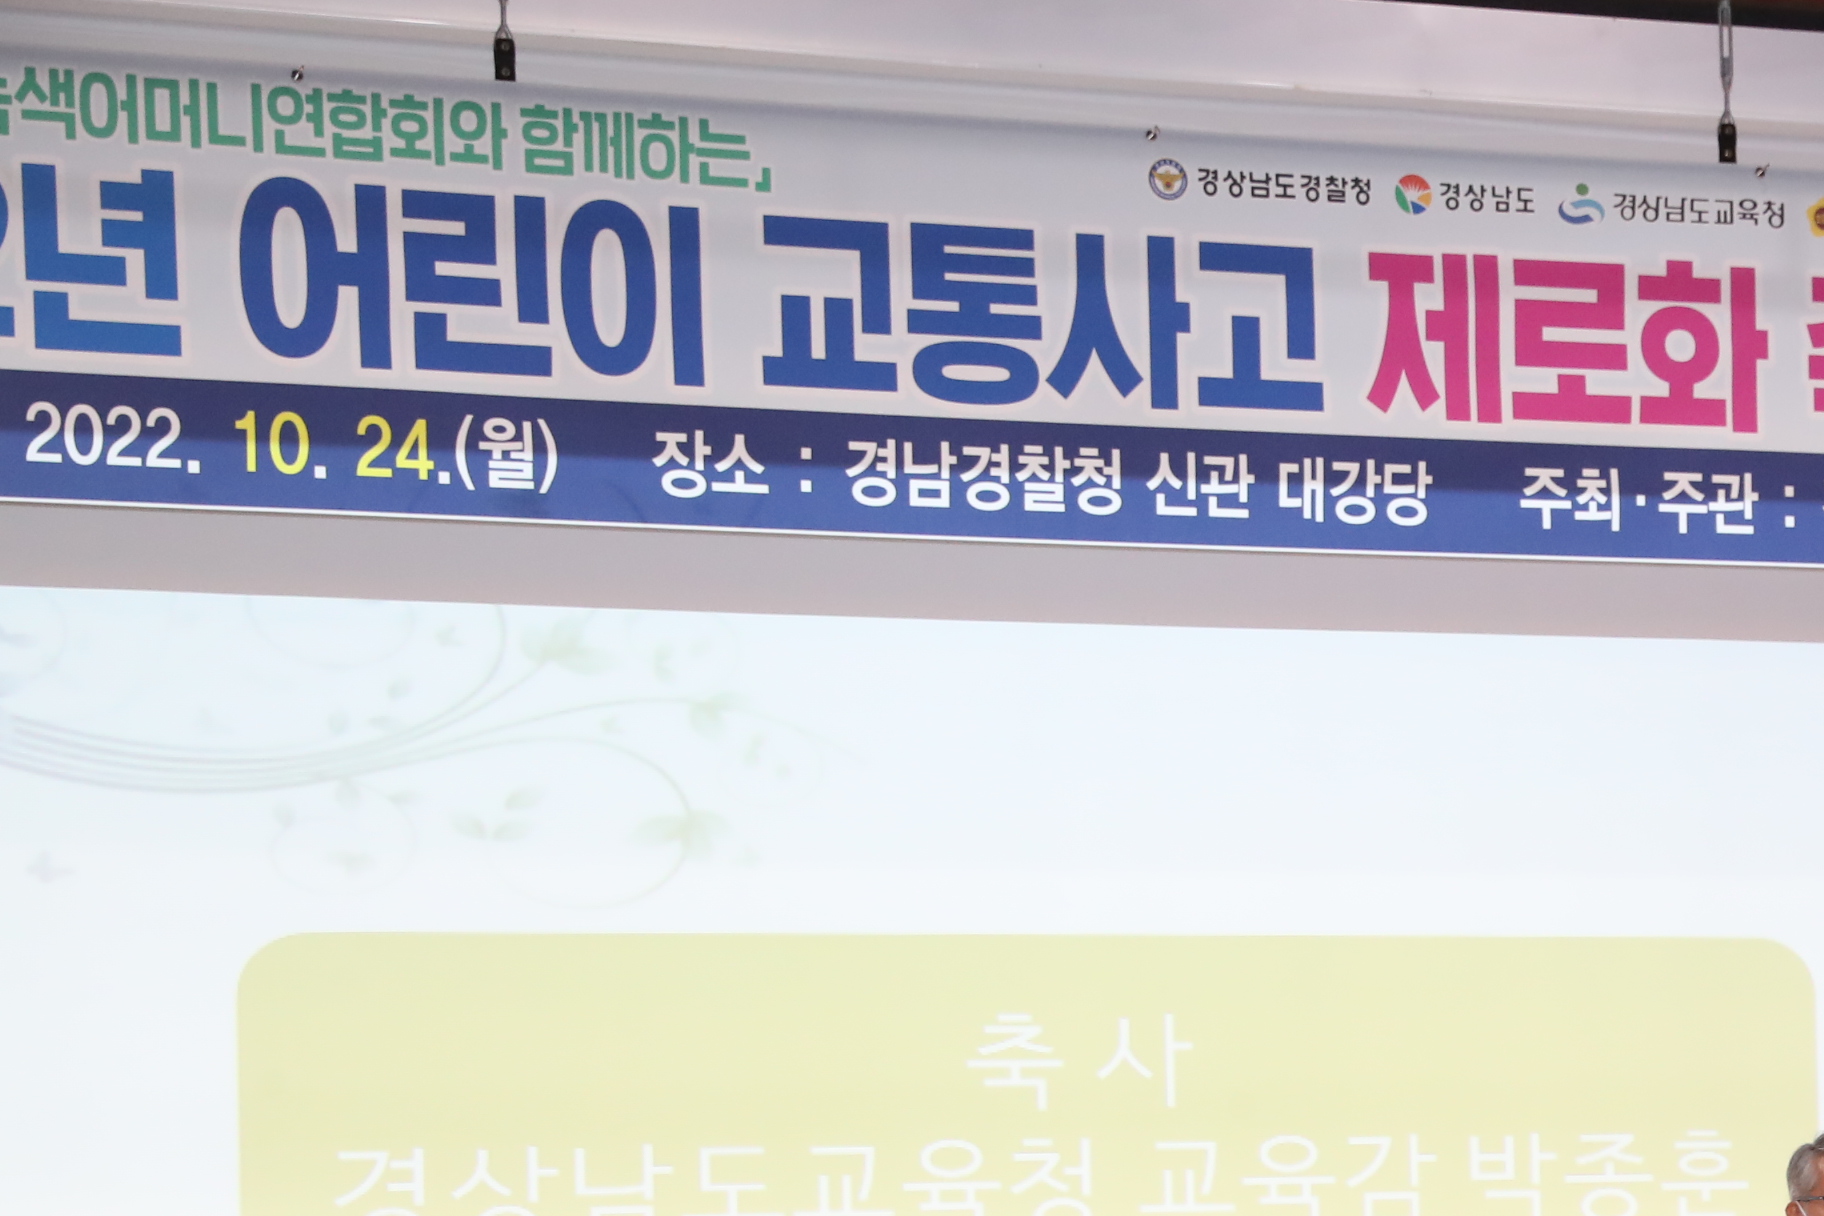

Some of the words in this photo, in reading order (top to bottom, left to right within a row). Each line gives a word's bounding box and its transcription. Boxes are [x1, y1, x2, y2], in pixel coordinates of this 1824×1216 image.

[0, 66, 506, 170] 색어머니연합회와
[1197, 167, 1372, 206] 경상남도경찰청
[1439, 181, 1536, 214] 경상남도
[1612, 192, 1786, 230] 경상남도교육청
[0, 163, 182, 357] 년
[239, 176, 706, 387] 어린이
[762, 214, 1325, 412] 교통사고
[1366, 251, 1769, 434] 제로화
[25, 401, 201, 474] 2022.
[234, 410, 327, 480] 10.
[651, 429, 770, 499] 장소
[844, 438, 1123, 516] 경남경찰청
[1145, 450, 1256, 519] 신관
[1278, 456, 1433, 527] 대강당
